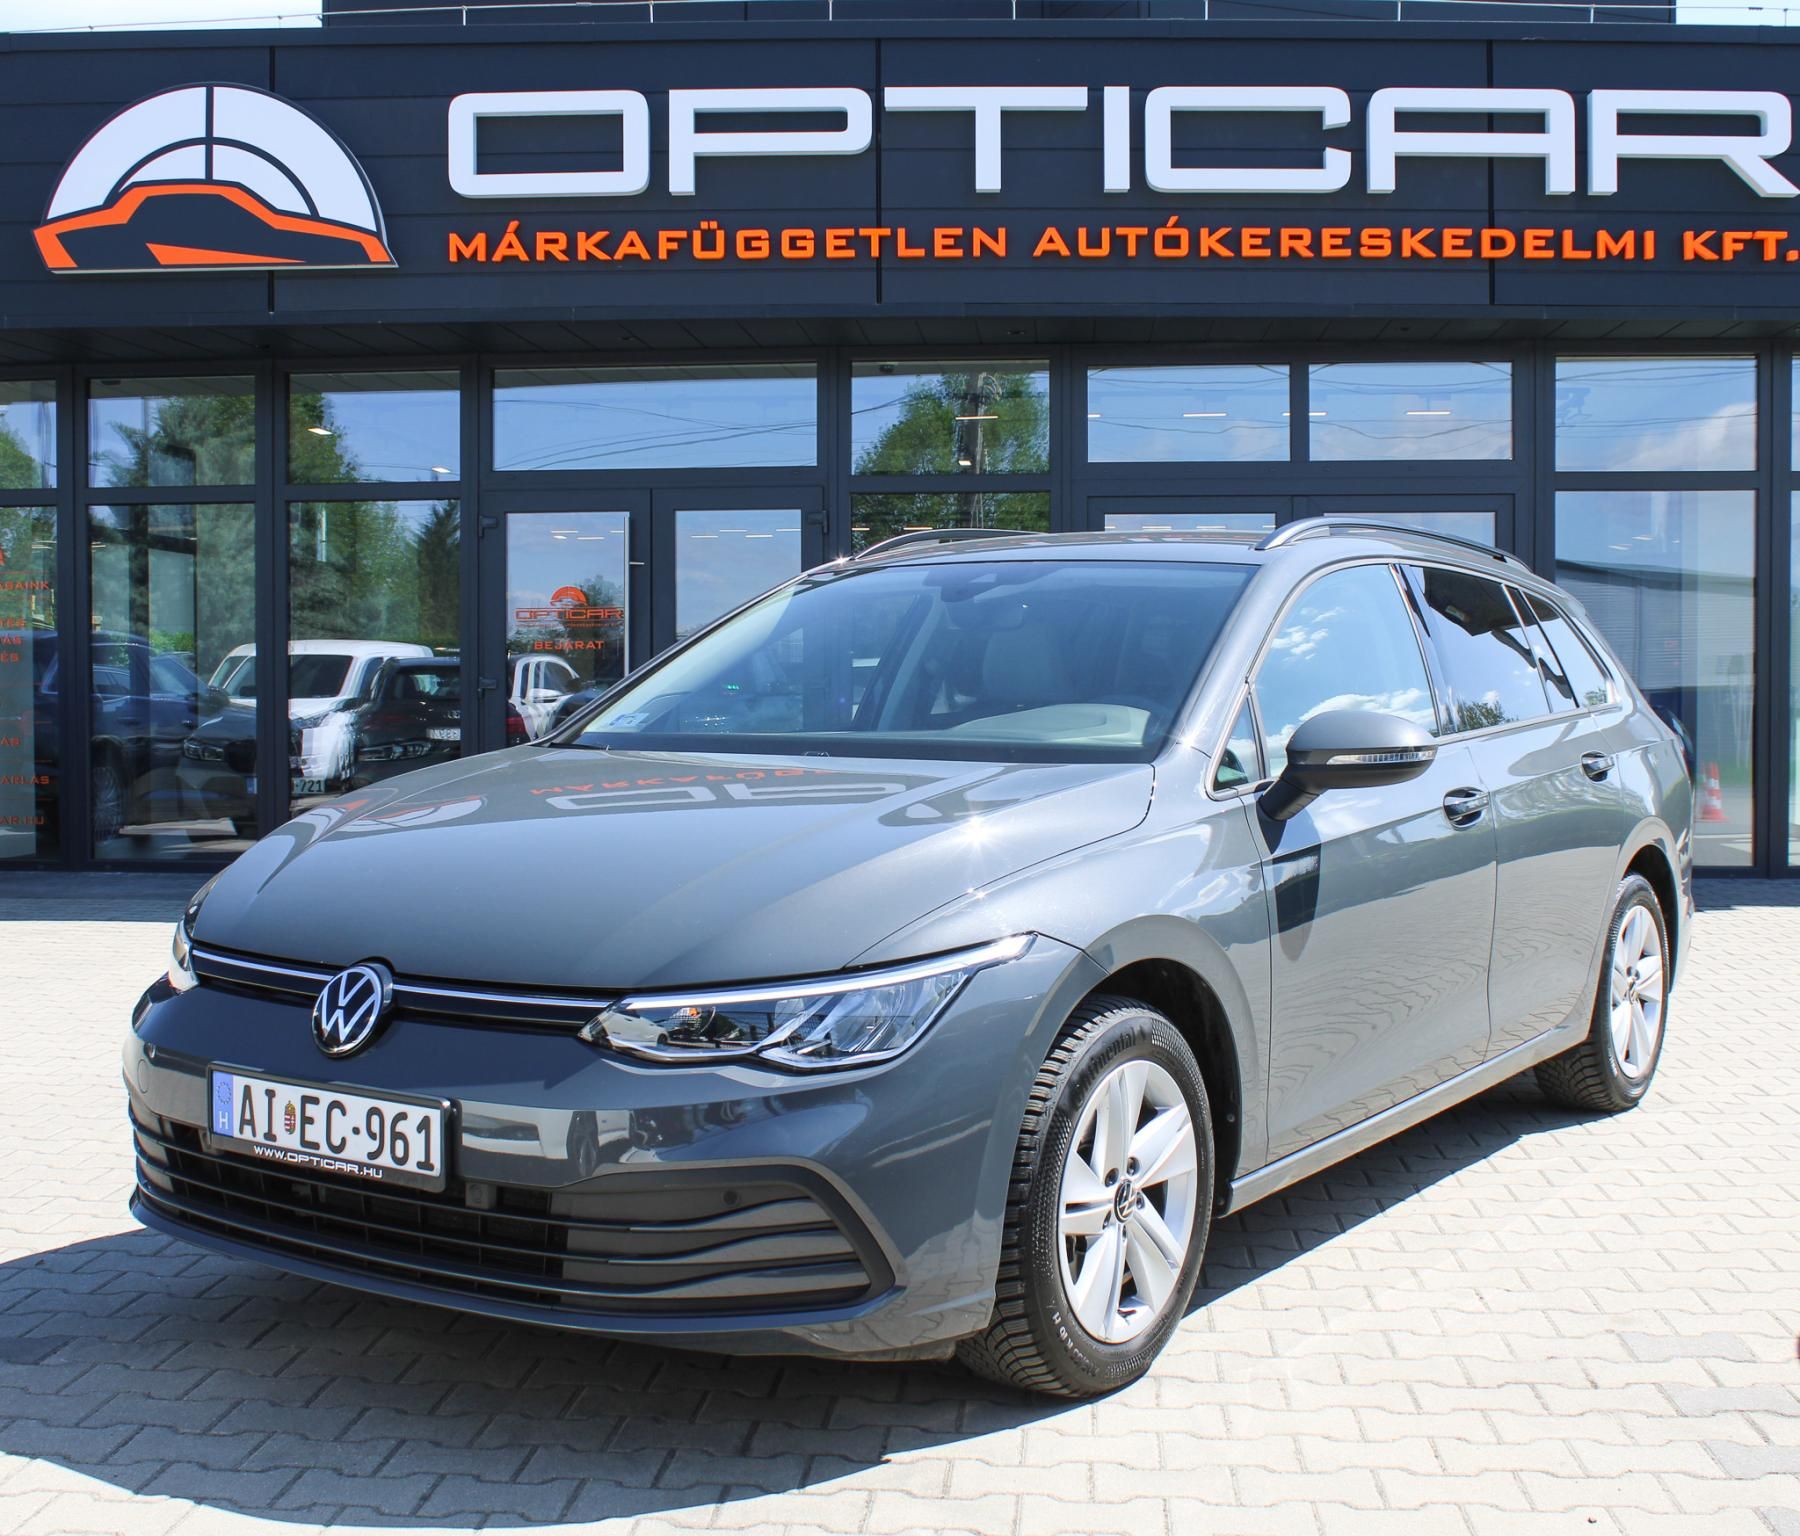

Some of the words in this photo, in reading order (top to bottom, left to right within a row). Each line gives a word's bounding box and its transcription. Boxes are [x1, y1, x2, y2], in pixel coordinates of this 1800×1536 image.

[447, 85, 1800, 198] OPTICAR
[448, 220, 1008, 263] MÁRKAFÜGGETLEN
[1032, 215, 1655, 260] AUTÓKERESKEDELMI
[1683, 229, 1800, 261] KFT.
[514, 608, 624, 620] OPTICAR
[219, 1111, 229, 1130] H
[253, 1145, 382, 1178] WWW.OPTICAR.HU
